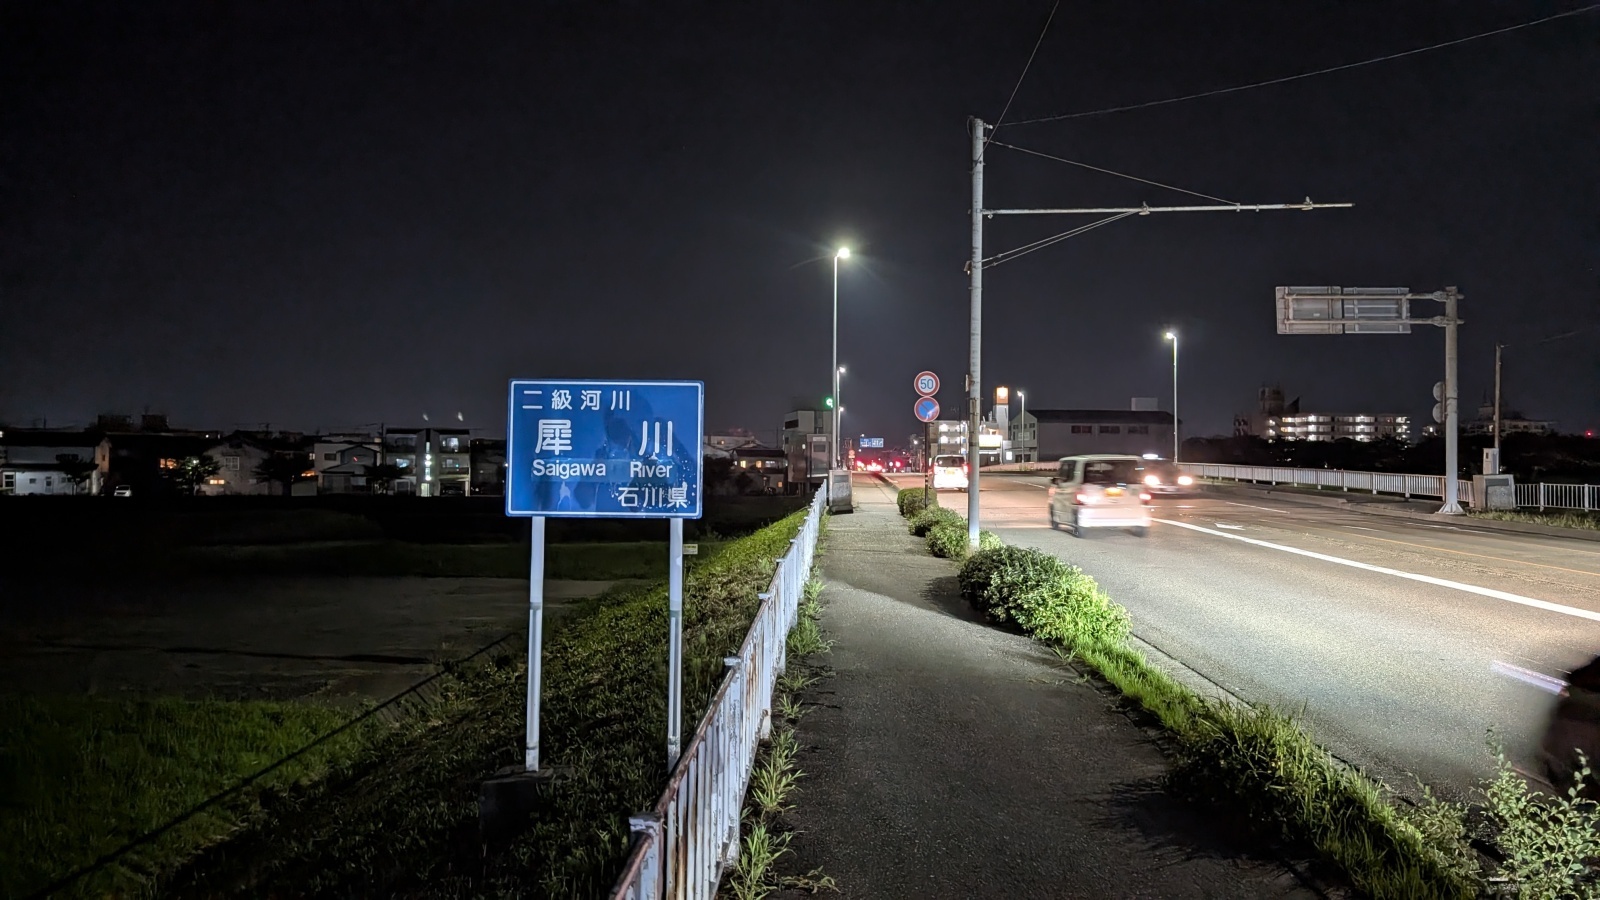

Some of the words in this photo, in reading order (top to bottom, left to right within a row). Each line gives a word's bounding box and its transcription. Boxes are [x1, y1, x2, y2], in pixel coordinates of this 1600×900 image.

[920, 378, 934, 390] 50
[522, 389, 631, 411] 二級河川
[535, 419, 673, 457] 犀川
[532, 459, 606, 479] Saigawa
[630, 461, 673, 478] River
[618, 485, 688, 508] 石川県
